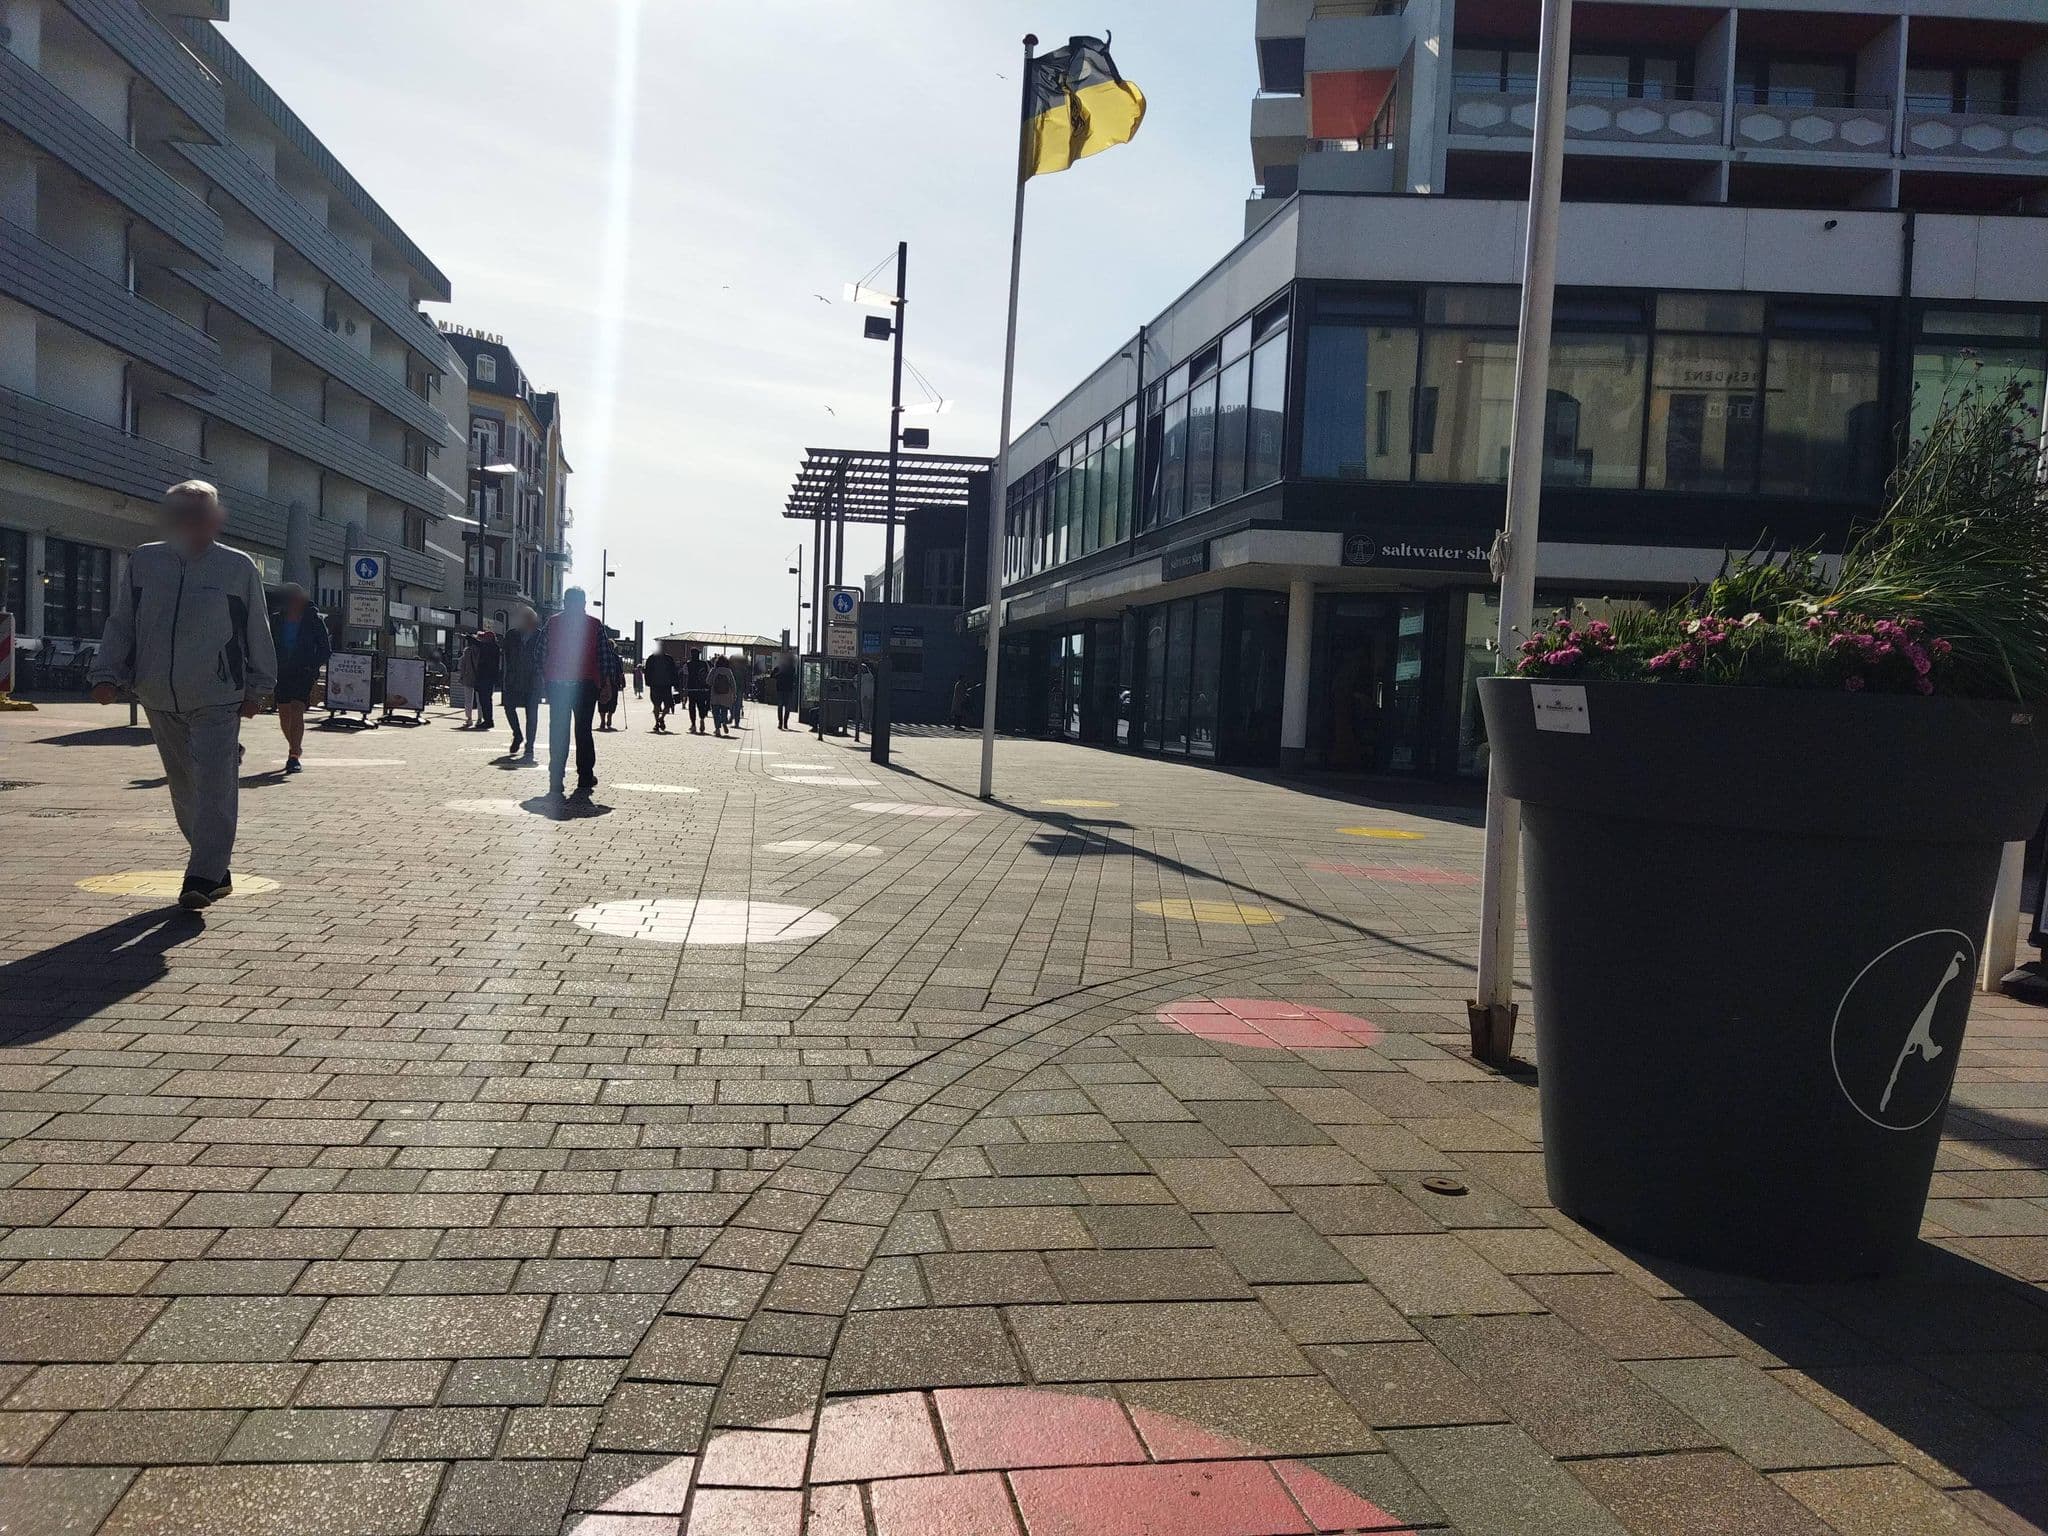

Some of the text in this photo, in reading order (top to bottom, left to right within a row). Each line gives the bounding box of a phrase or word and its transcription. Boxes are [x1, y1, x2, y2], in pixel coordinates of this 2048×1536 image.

[438, 319, 504, 345] MIRAMAR
[1382, 542, 1492, 560] saltwater sh
[358, 580, 376, 588] ZONE
